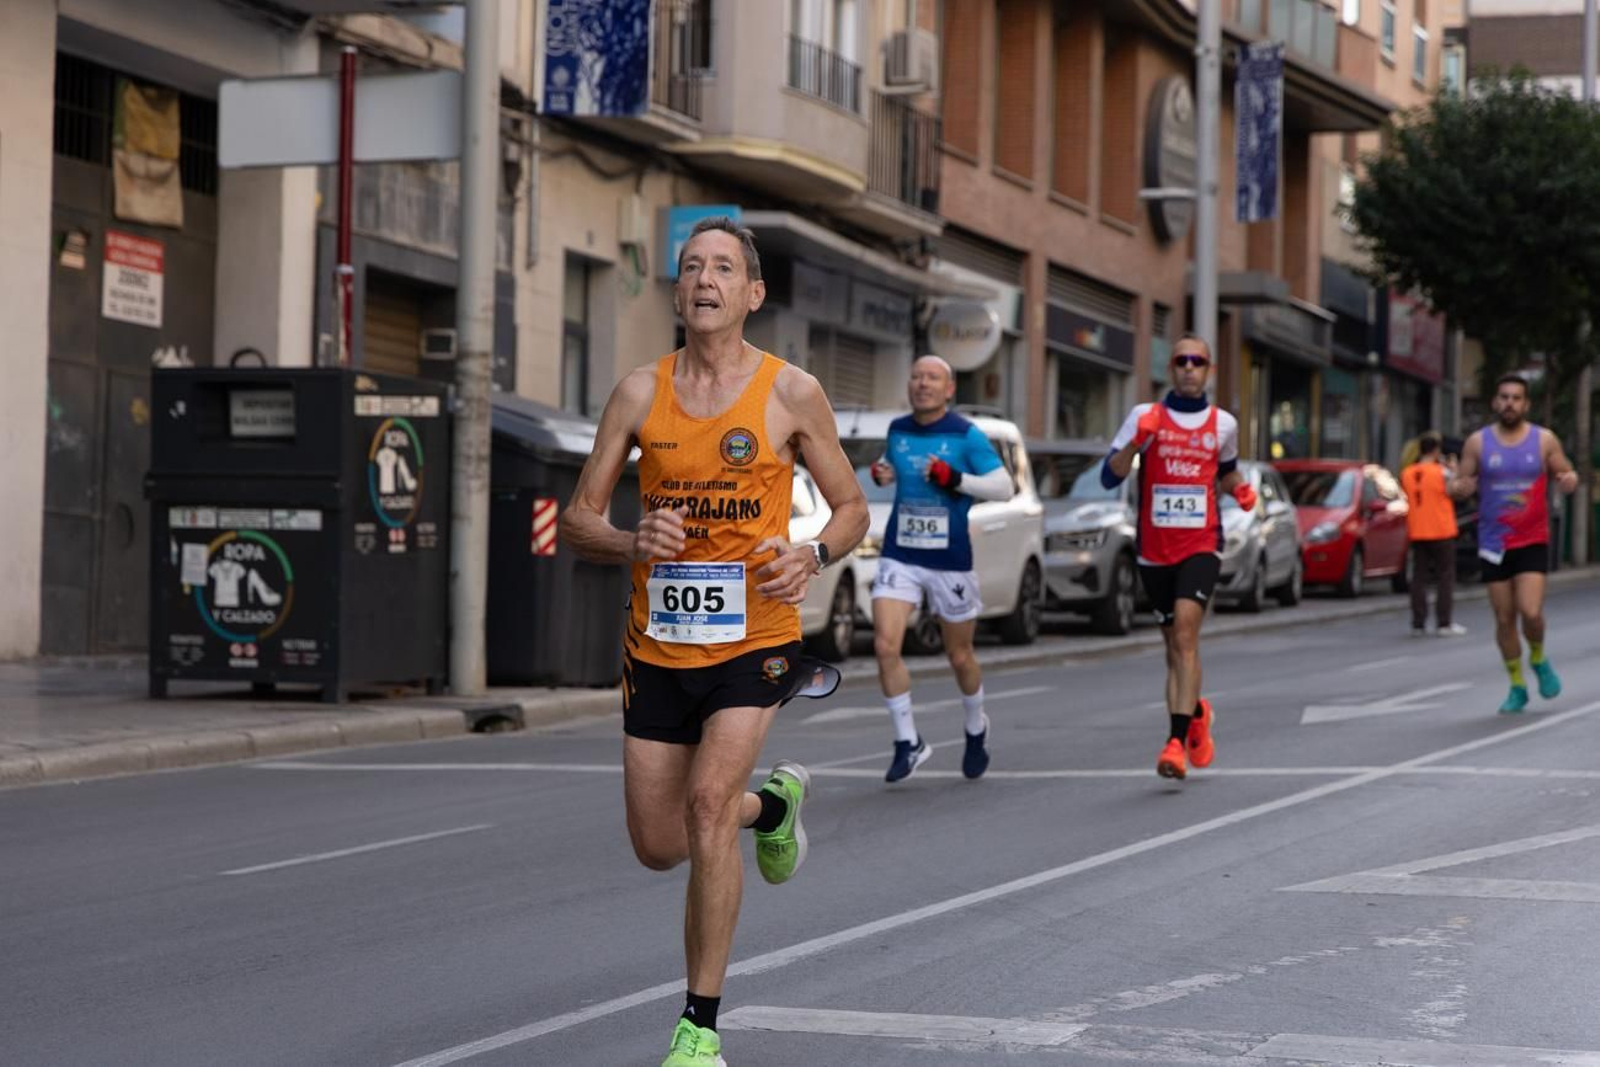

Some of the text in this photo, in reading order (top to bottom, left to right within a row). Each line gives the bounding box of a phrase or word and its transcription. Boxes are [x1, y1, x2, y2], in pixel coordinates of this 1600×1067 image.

[661, 480, 738, 492] CLUB DE ATLETISMO
[1162, 497, 1197, 512] 143
[906, 517, 938, 533] 536
[224, 544, 266, 561] ROPA
[662, 585, 725, 613] 605
[222, 609, 276, 624] CALZADO
